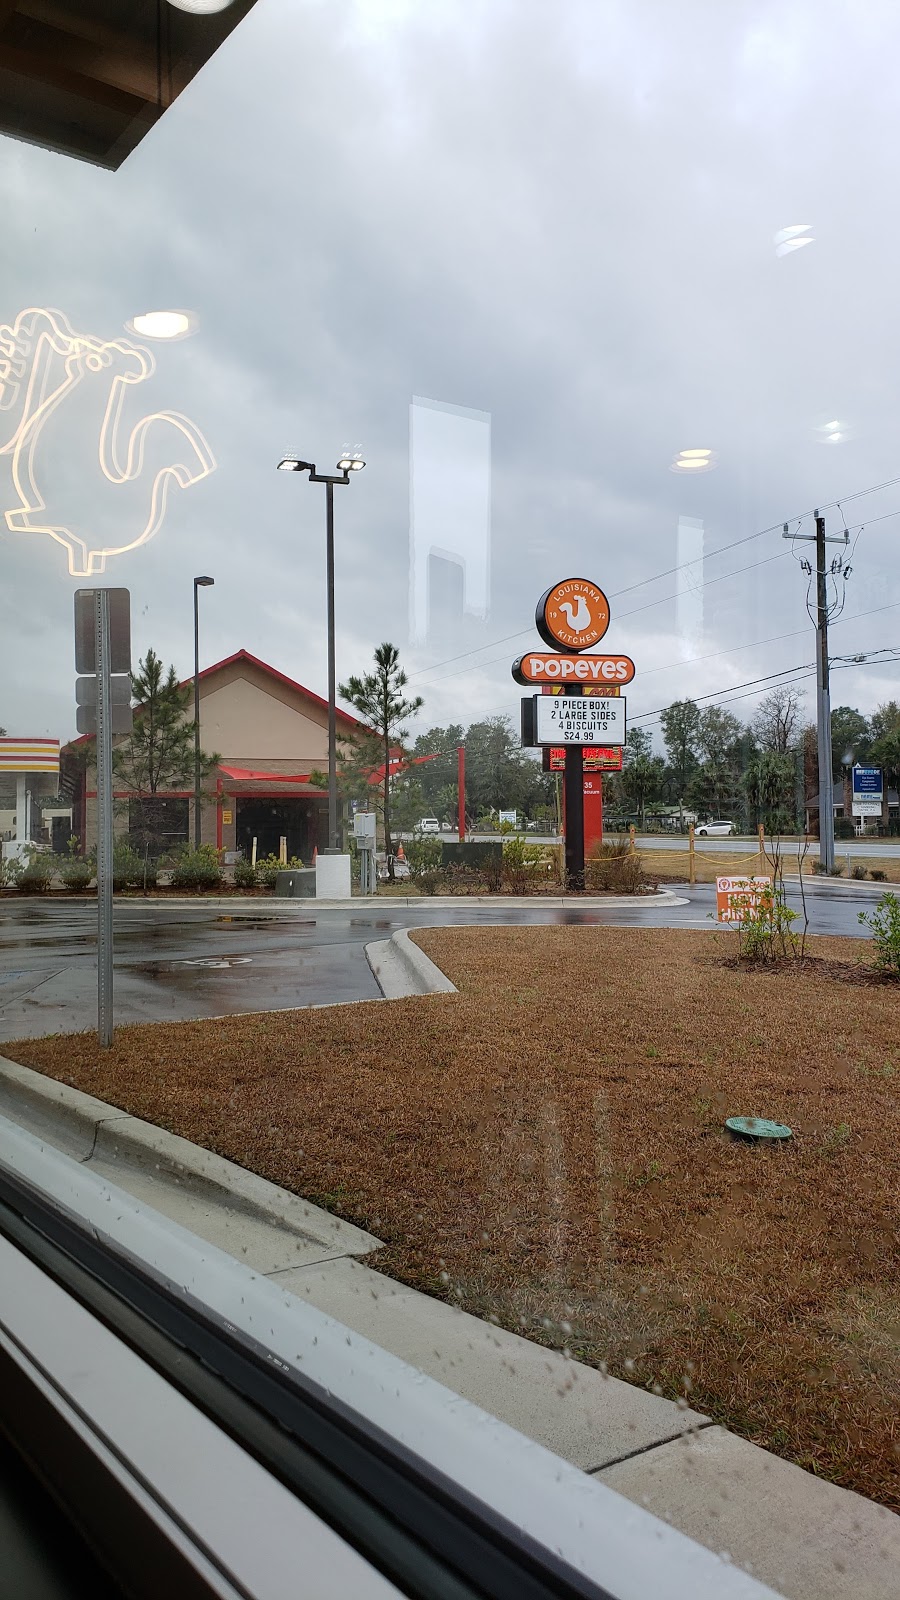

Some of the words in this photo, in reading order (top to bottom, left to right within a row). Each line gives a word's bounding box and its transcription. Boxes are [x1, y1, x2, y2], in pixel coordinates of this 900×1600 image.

[553, 583, 600, 603] LOUISIANA
[557, 629, 598, 644] KITCHEN
[529, 658, 628, 680] POPEYES
[554, 700, 559, 709] 9
[562, 700, 588, 710] PIECE
[589, 701, 610, 710] BOX!
[551, 711, 556, 719] 2
[559, 710, 588, 720] LARGE
[591, 711, 617, 721] SIDES
[558, 721, 564, 730] 4
[566, 721, 608, 731] BISCUITS
[564, 731, 594, 741] $24.99
[721, 907, 770, 921] HIRN
